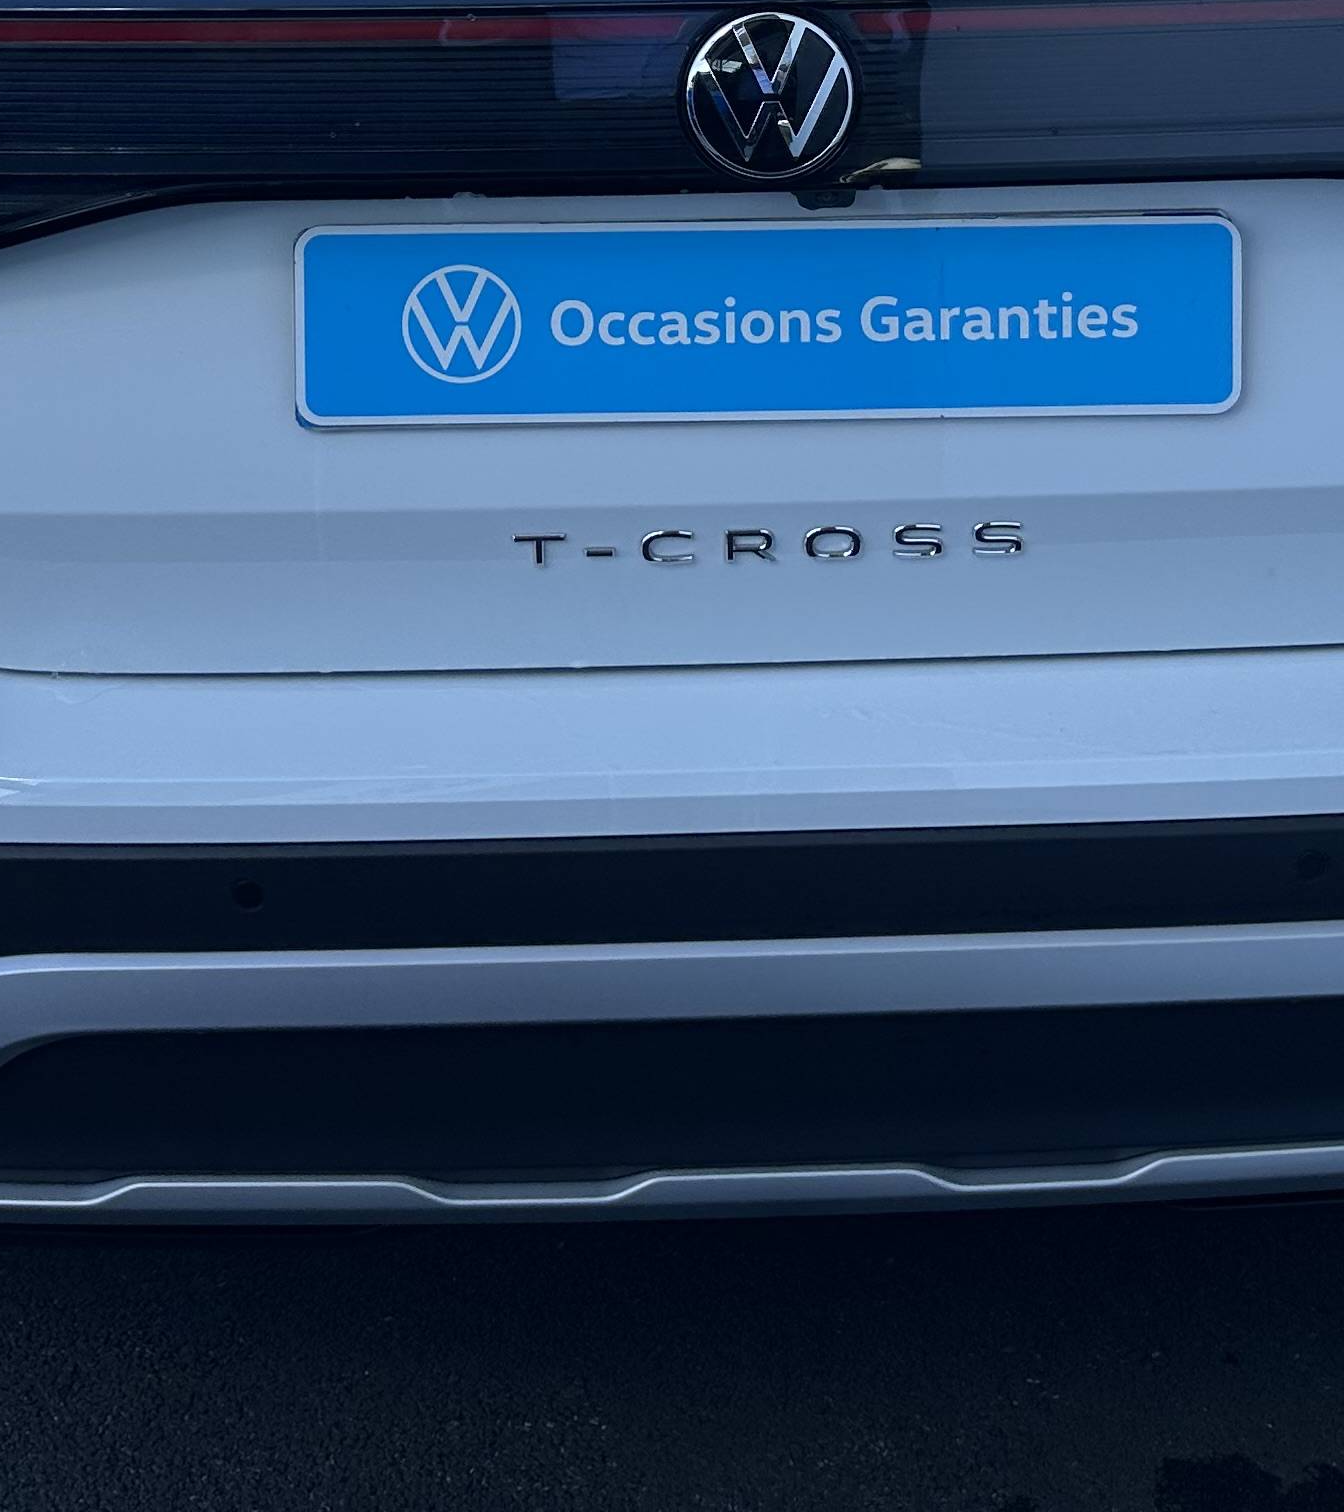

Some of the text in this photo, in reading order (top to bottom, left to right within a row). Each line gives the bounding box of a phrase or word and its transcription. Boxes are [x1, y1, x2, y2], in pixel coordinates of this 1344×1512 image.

[549, 297, 841, 348] Occasions
[859, 290, 1140, 343] Garanties
[511, 519, 1025, 566] T-CROSS
